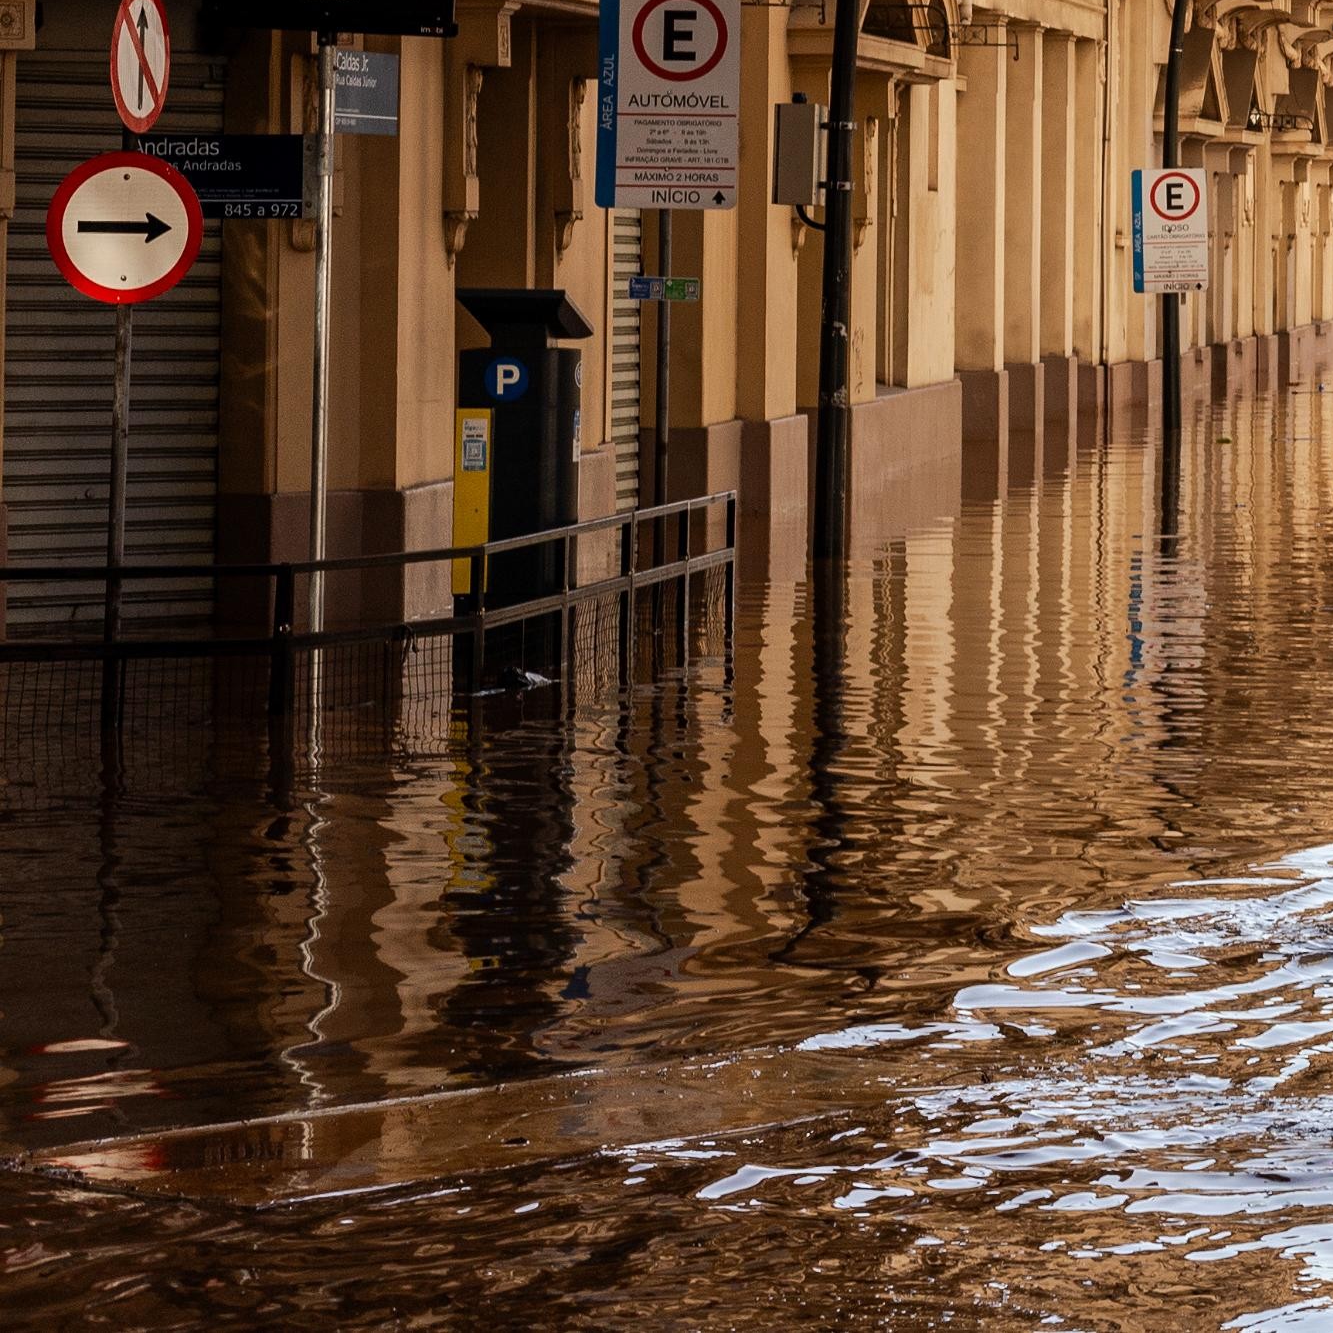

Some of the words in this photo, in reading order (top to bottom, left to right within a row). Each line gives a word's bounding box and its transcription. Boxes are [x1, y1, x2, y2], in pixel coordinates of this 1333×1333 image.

[663, 10, 697, 61] E
[336, 52, 360, 72] Caldas
[361, 54, 369, 73] Jr.
[603, 54, 615, 86] AZUL
[628, 91, 729, 108] AUTOMÓVEL
[183, 160, 242, 171] Andradas
[634, 171, 674, 182] MÁXIMO
[676, 173, 681, 182] 2
[684, 173, 719, 182] HORAS
[651, 188, 701, 204] INÍCIO
[1166, 183, 1184, 210] E
[224, 204, 251, 217] 845
[257, 207, 265, 216] a
[271, 204, 298, 217] 972
[1162, 224, 1190, 232] IDOSO
[496, 364, 521, 395] P
